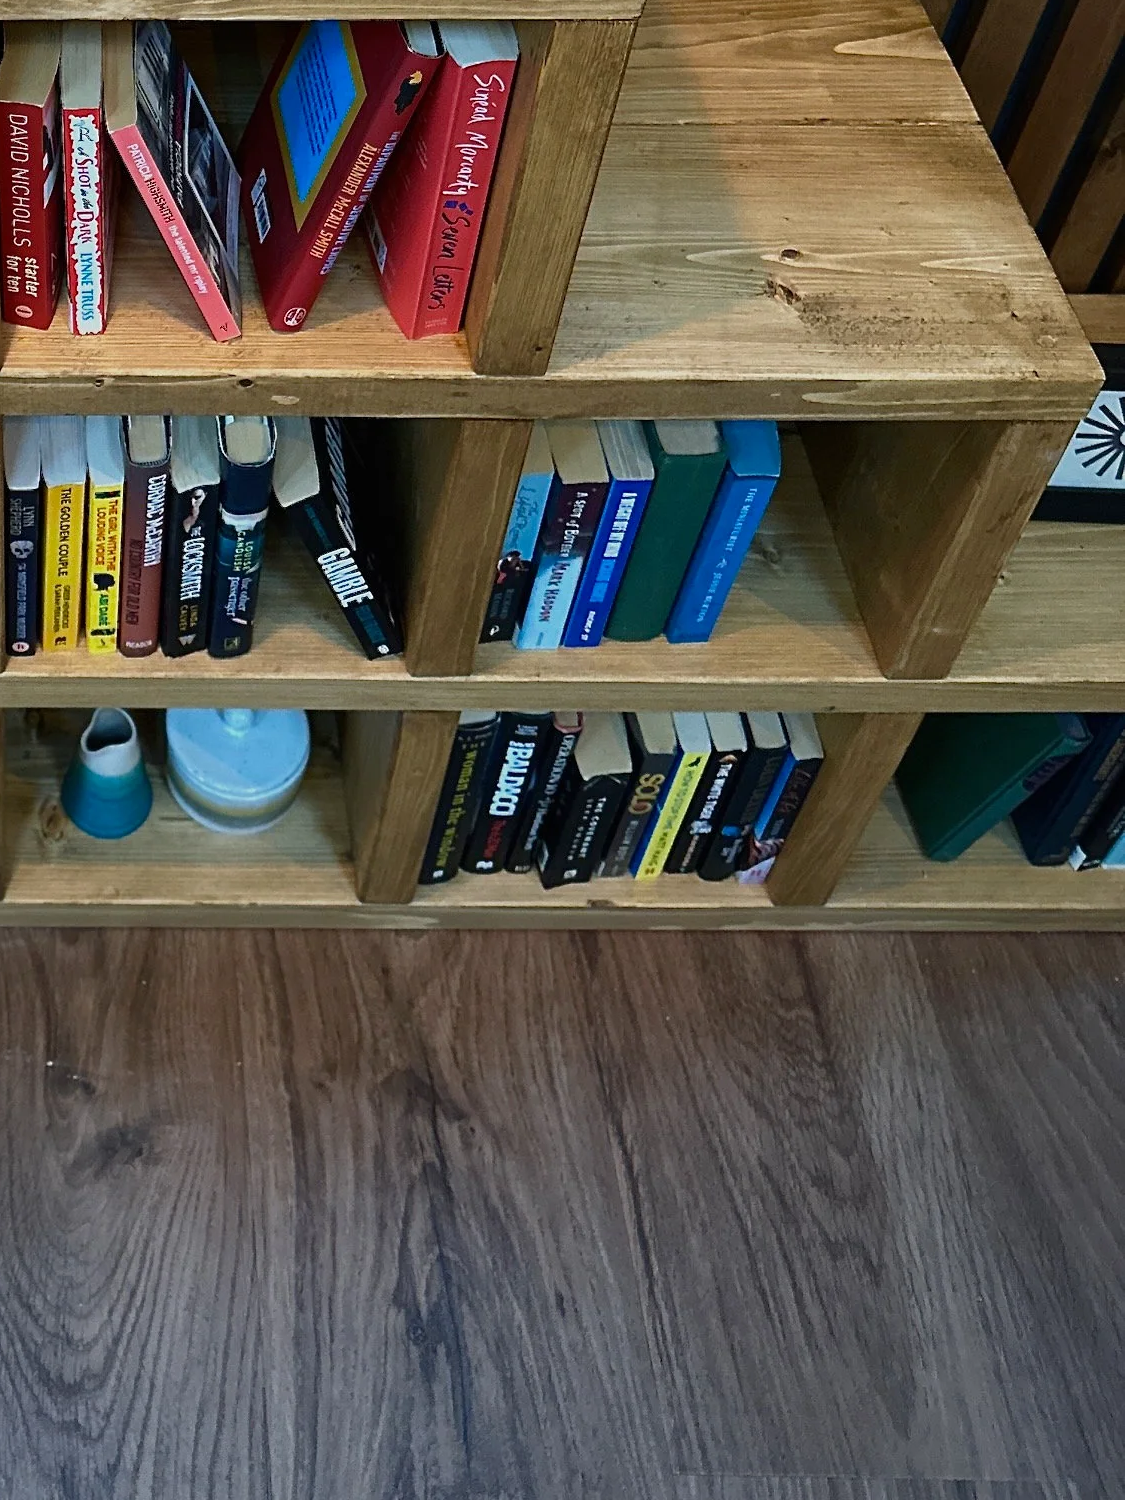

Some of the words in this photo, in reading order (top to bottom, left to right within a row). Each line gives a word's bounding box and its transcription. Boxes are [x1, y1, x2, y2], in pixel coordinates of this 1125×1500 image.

[467, 73, 506, 124] Sinéad
[8, 113, 29, 163] DAVID
[127, 143, 153, 182] PATRICIA
[441, 130, 489, 195] Moriarty
[10, 166, 32, 249] NICHOLLS
[145, 177, 176, 224] HIGHSMITH
[323, 195, 352, 227] McCALL
[167, 224, 180, 240] the
[309, 229, 334, 260] SMITH
[436, 211, 471, 259] Seven
[5, 255, 22, 272] for
[174, 239, 195, 266] talented
[7, 274, 22, 293] ten
[24, 255, 40, 298] starter
[79, 253, 94, 287] LYNNE
[187, 263, 198, 277] mr
[191, 274, 209, 295] ripley
[80, 287, 94, 322] TRUSS
[426, 264, 465, 311] Letters
[60, 487, 73, 504] THE
[108, 500, 119, 515] THE
[145, 473, 167, 518] CORMAC
[9, 498, 23, 536] SHEPHERD
[22, 505, 36, 528] LYNN
[59, 505, 72, 543] GOLDEN
[96, 507, 107, 542] LOUDING
[108, 515, 118, 534] GIRL
[95, 543, 106, 566] VOICE
[107, 534, 117, 555] WITH
[143, 518, 164, 567] McCARTHY
[233, 530, 246, 573] CANDLISH
[243, 539, 255, 572] LOUISE
[57, 544, 69, 578] COUPLE
[106, 555, 116, 572] THE
[179, 536, 206, 601] LOCKSMITH
[317, 547, 375, 608] GAMBLE
